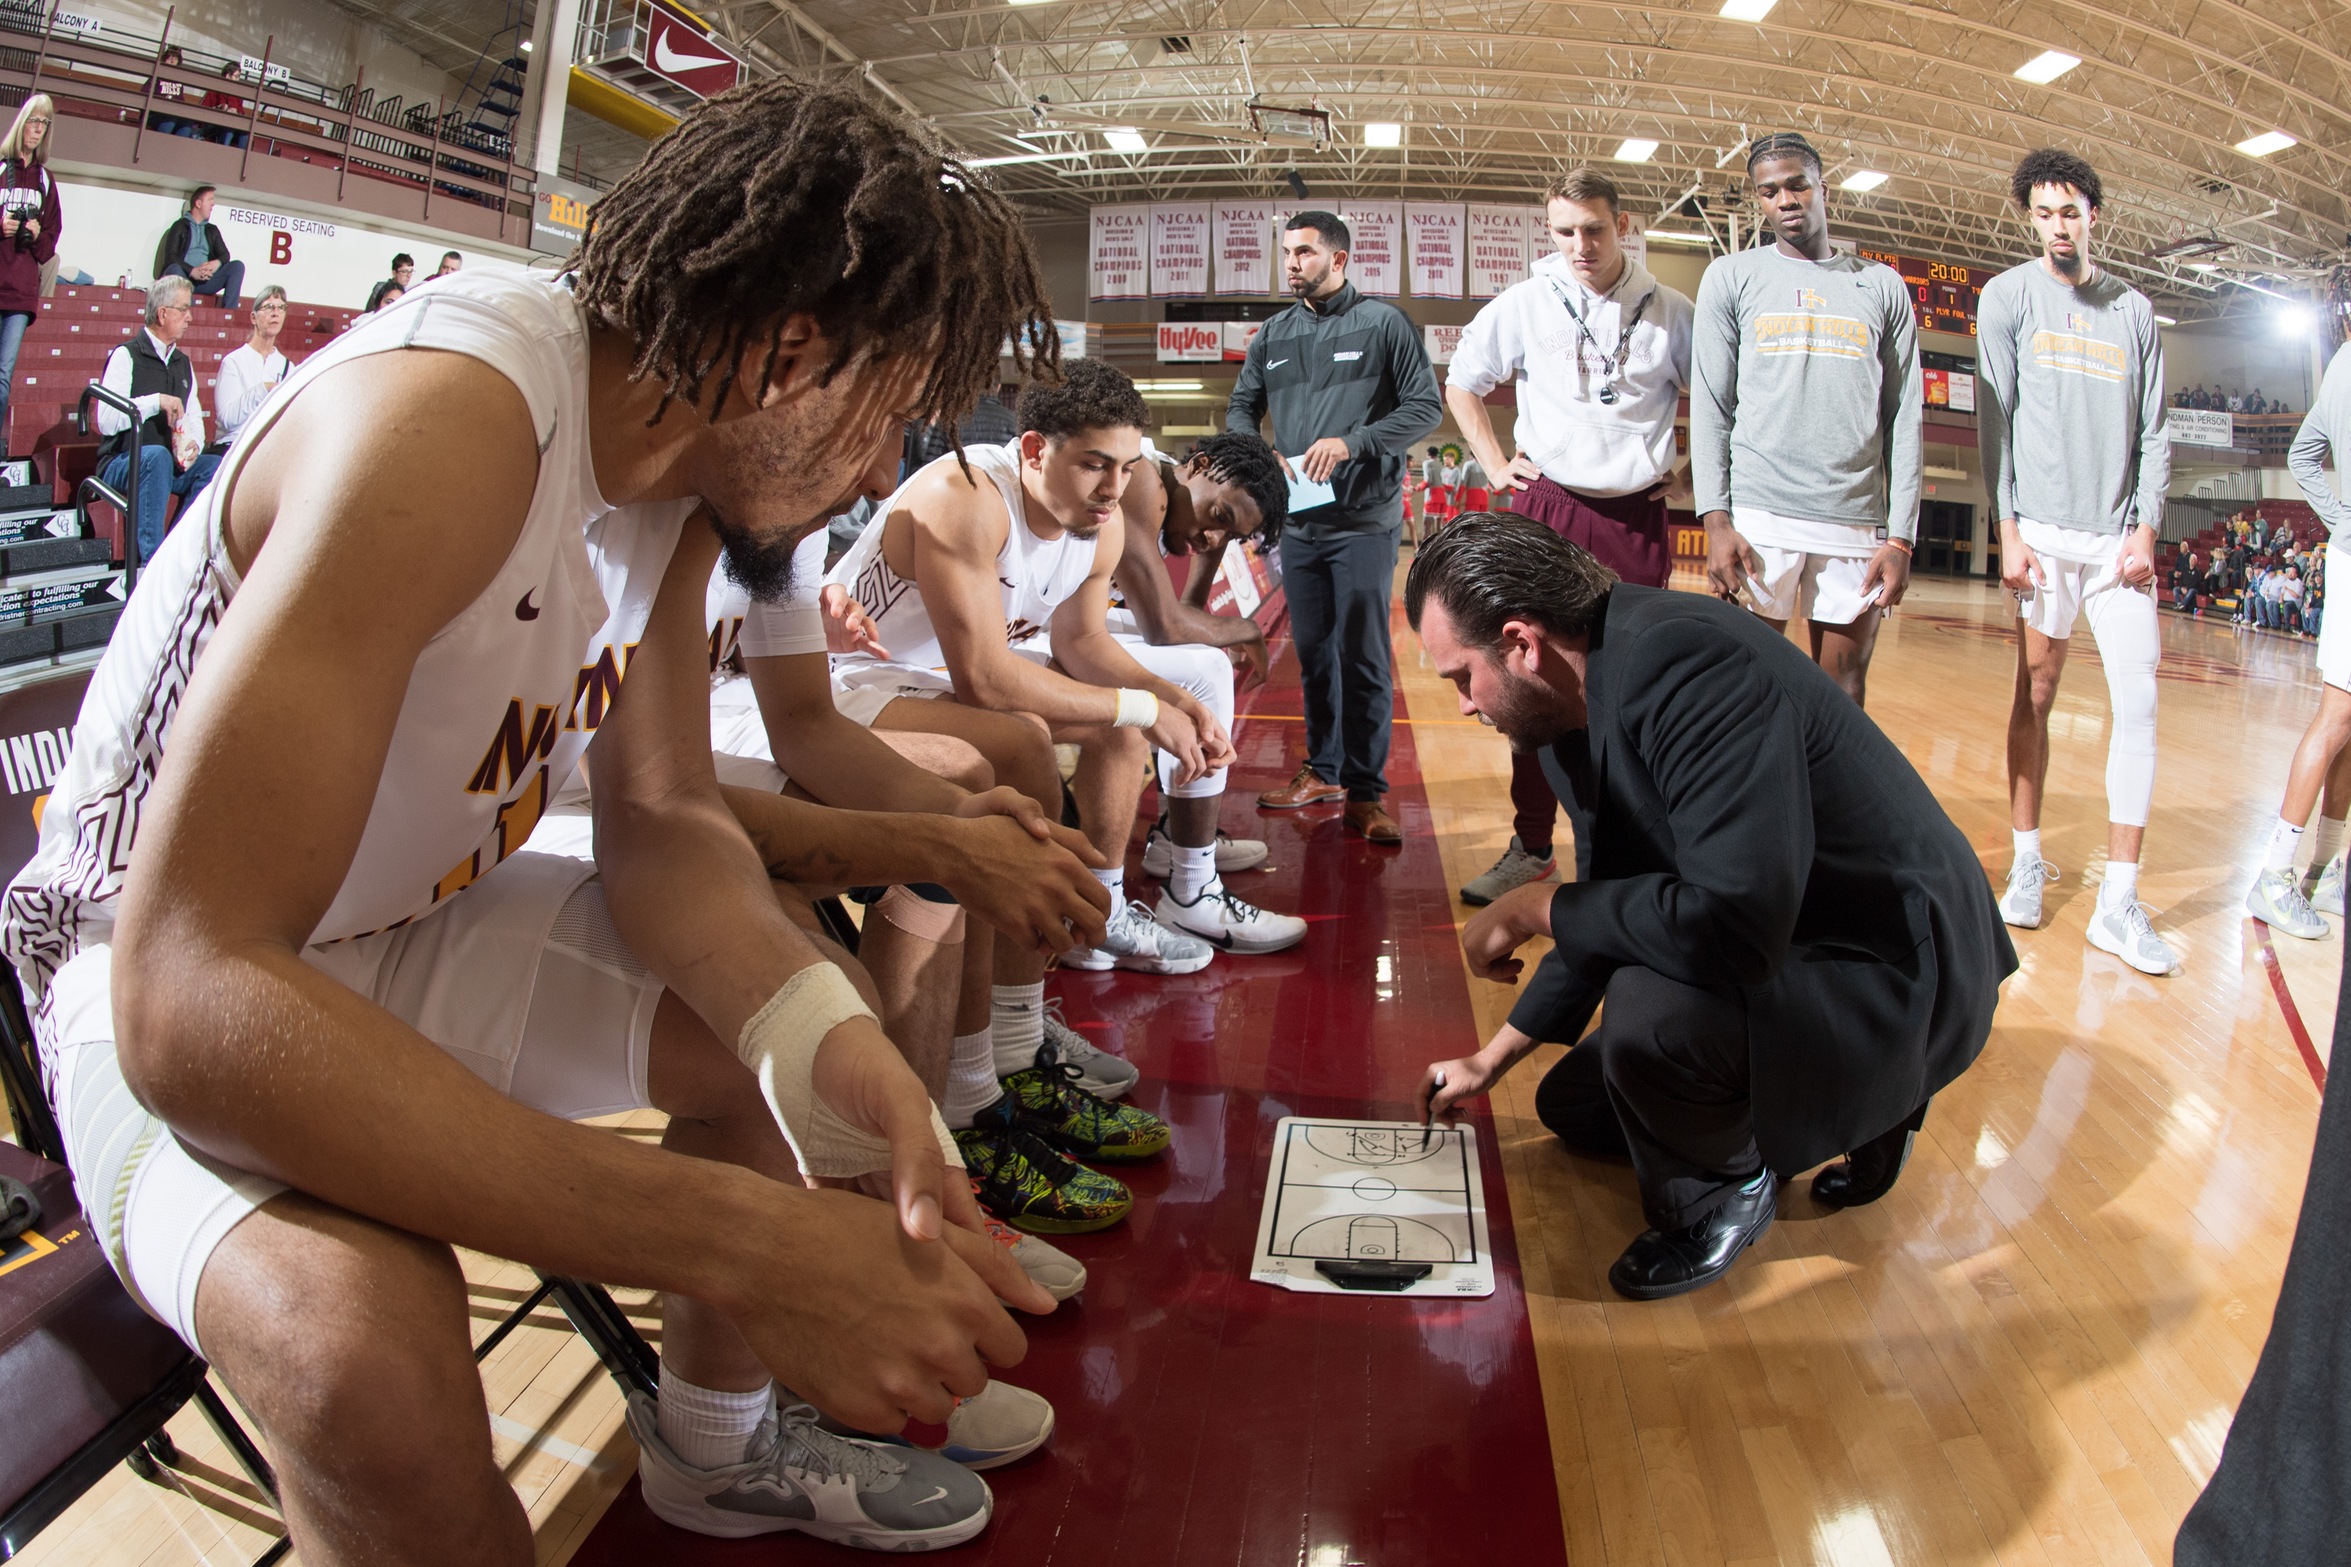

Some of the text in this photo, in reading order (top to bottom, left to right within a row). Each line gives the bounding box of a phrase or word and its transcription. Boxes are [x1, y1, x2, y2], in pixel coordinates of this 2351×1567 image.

[53, 12, 98, 31] ALCONY A
[281, 69, 288, 79] B
[538, 192, 552, 204] GO
[1096, 214, 1144, 228] NJCAA
[1156, 214, 1204, 224] NJCAA
[1221, 210, 1264, 221] NJCAA
[1350, 212, 1394, 224] NJCAA
[1412, 214, 1457, 226] NJCAA
[1472, 214, 1522, 227] NJCAA
[230, 208, 336, 238] RESERVED SEATING
[536, 222, 566, 238] Download
[565, 231, 576, 240] the
[270, 230, 292, 266] B
[1226, 237, 1259, 247] NATIONAL
[1355, 240, 1388, 250] NATIONAL
[1098, 246, 1138, 258] NATIONAL
[1160, 244, 1200, 254] NATIONAL
[1224, 250, 1262, 260] CHAMPIONS
[1418, 244, 1452, 254] NATIONAL
[1476, 246, 1520, 258] NATIONAL
[1156, 258, 1204, 268] CHAMPIONS
[1353, 254, 1391, 264] CHAMPIONS
[1416, 256, 1454, 268] CHAMPIONS
[1884, 254, 1896, 263] PTS
[1094, 260, 1142, 272] CHAMPIONS
[1474, 259, 1522, 271] CHAMPIONS
[1170, 272, 1189, 281] 2011
[1930, 262, 1968, 283] 20:00
[1918, 286, 1954, 305] 0 1
[1924, 316, 1976, 334] 6 6
[1754, 316, 1868, 347] INDIAN HILLS
[1778, 336, 1844, 349] BASKETBALL
[2032, 333, 2084, 354] INDIAN
[2053, 354, 2108, 372] BASKETBALL
[2195, 426, 2227, 434] CONDITIONING
[32, 590, 42, 598] to
[44, 583, 81, 598] fulfilling
[82, 581, 98, 589] our
[58, 1230, 80, 1244] TM
